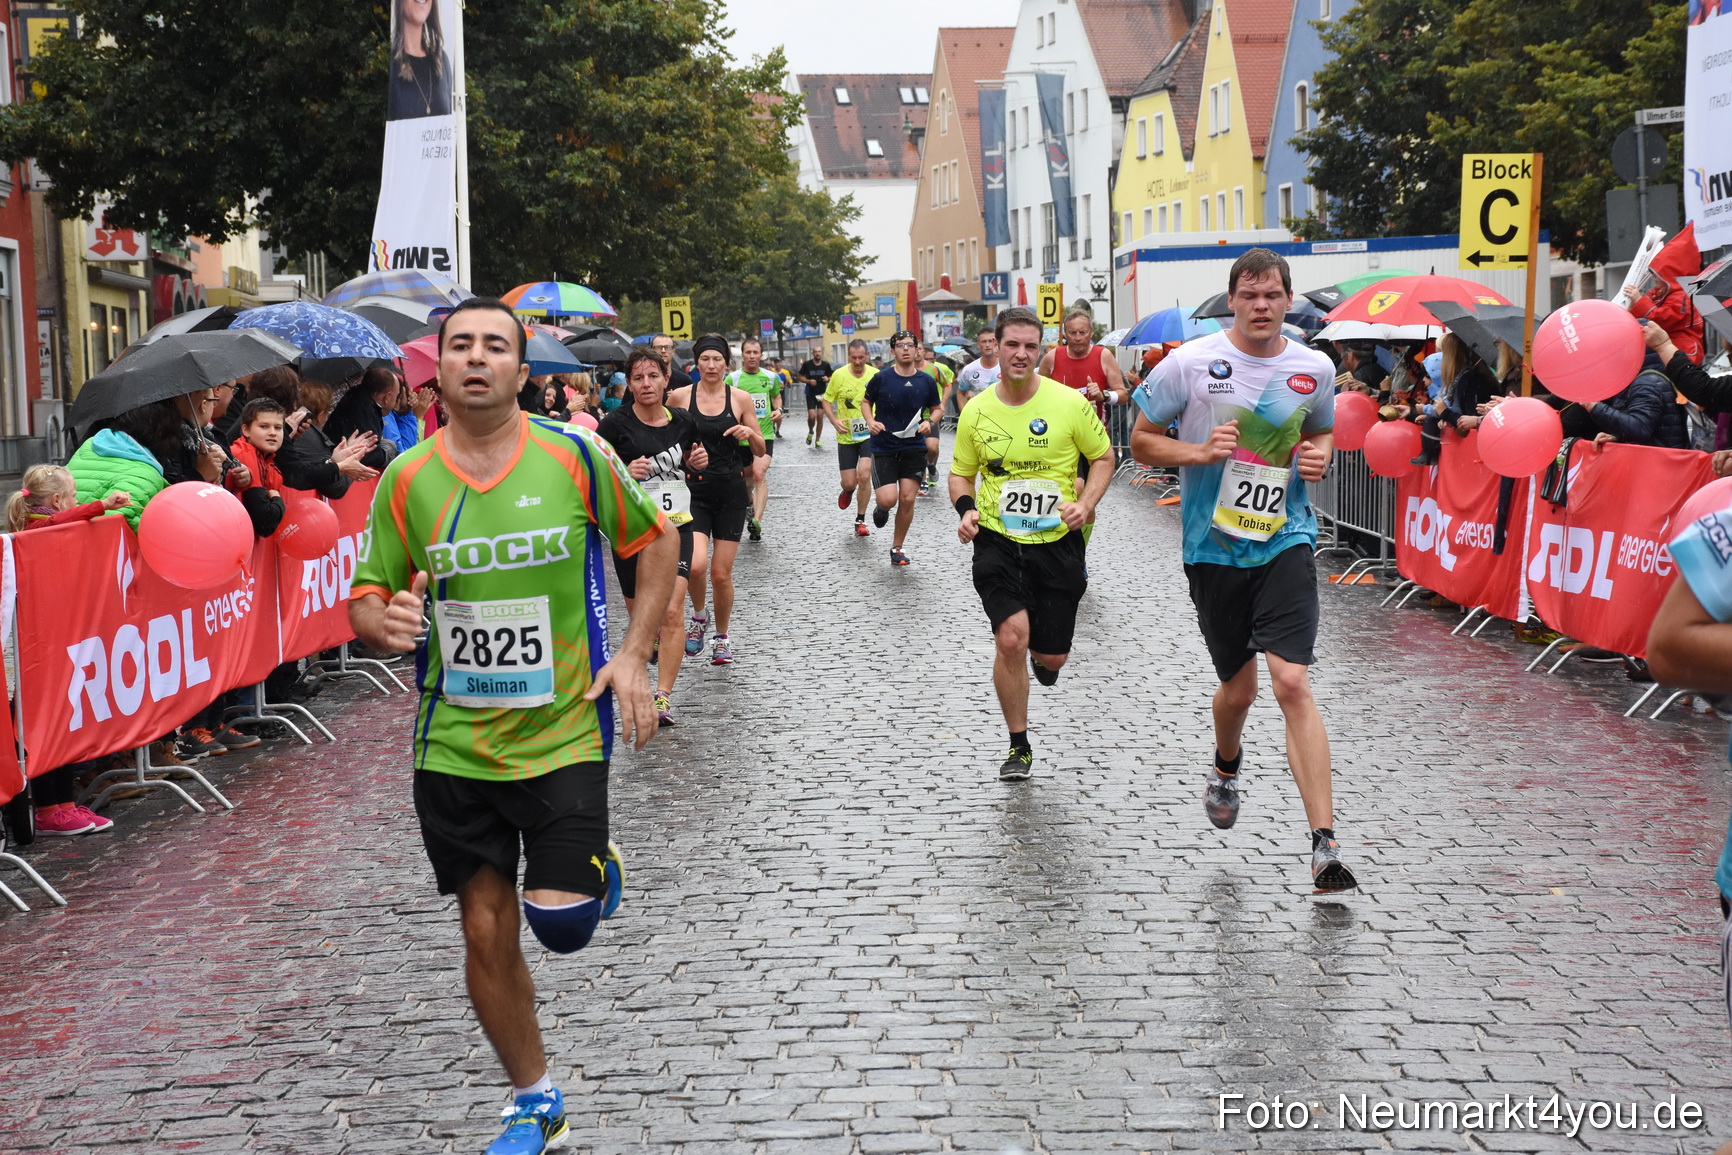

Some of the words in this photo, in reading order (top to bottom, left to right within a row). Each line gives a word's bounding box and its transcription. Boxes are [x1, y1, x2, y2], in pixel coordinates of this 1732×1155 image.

[1646, 111, 1668, 121] Ulmer
[1471, 158, 1532, 179] Block
[1147, 179, 1165, 200] HOTEL
[1480, 188, 1520, 245] C
[1039, 285, 1060, 293] Block
[664, 299, 687, 307] Block
[1043, 297, 1057, 318] D
[669, 310, 685, 331] D
[752, 399, 766, 410] 53
[1028, 437, 1049, 445] Partl
[662, 493, 673, 511] 5
[1006, 491, 1060, 516] 2917
[1234, 480, 1285, 514] 202
[1021, 519, 1039, 529] Ralf
[1238, 515, 1272, 532] Tobias
[425, 525, 571, 580] BOCK
[481, 602, 540, 618] BOCK
[451, 625, 543, 668] 2825
[467, 676, 528, 693] Sleiman
